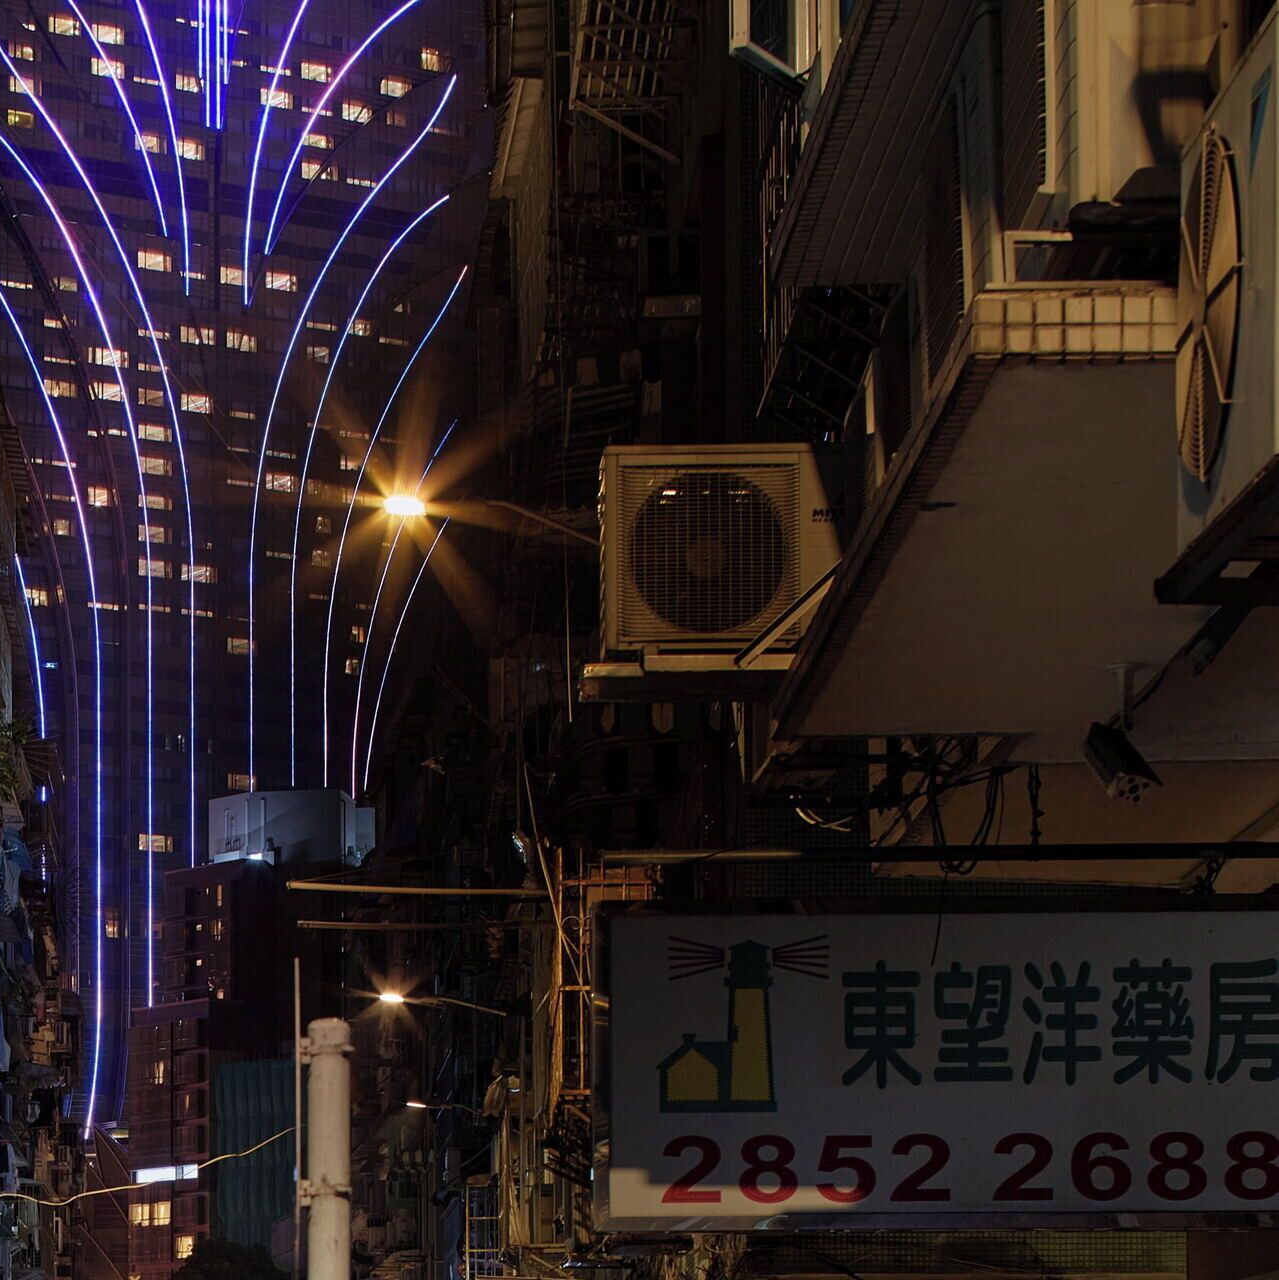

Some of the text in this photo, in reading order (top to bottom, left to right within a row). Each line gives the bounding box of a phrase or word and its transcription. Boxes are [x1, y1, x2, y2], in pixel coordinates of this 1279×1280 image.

[841, 958, 1279, 1089] 東望洋藥房
[661, 1131, 1279, 1204] 2852 2688
